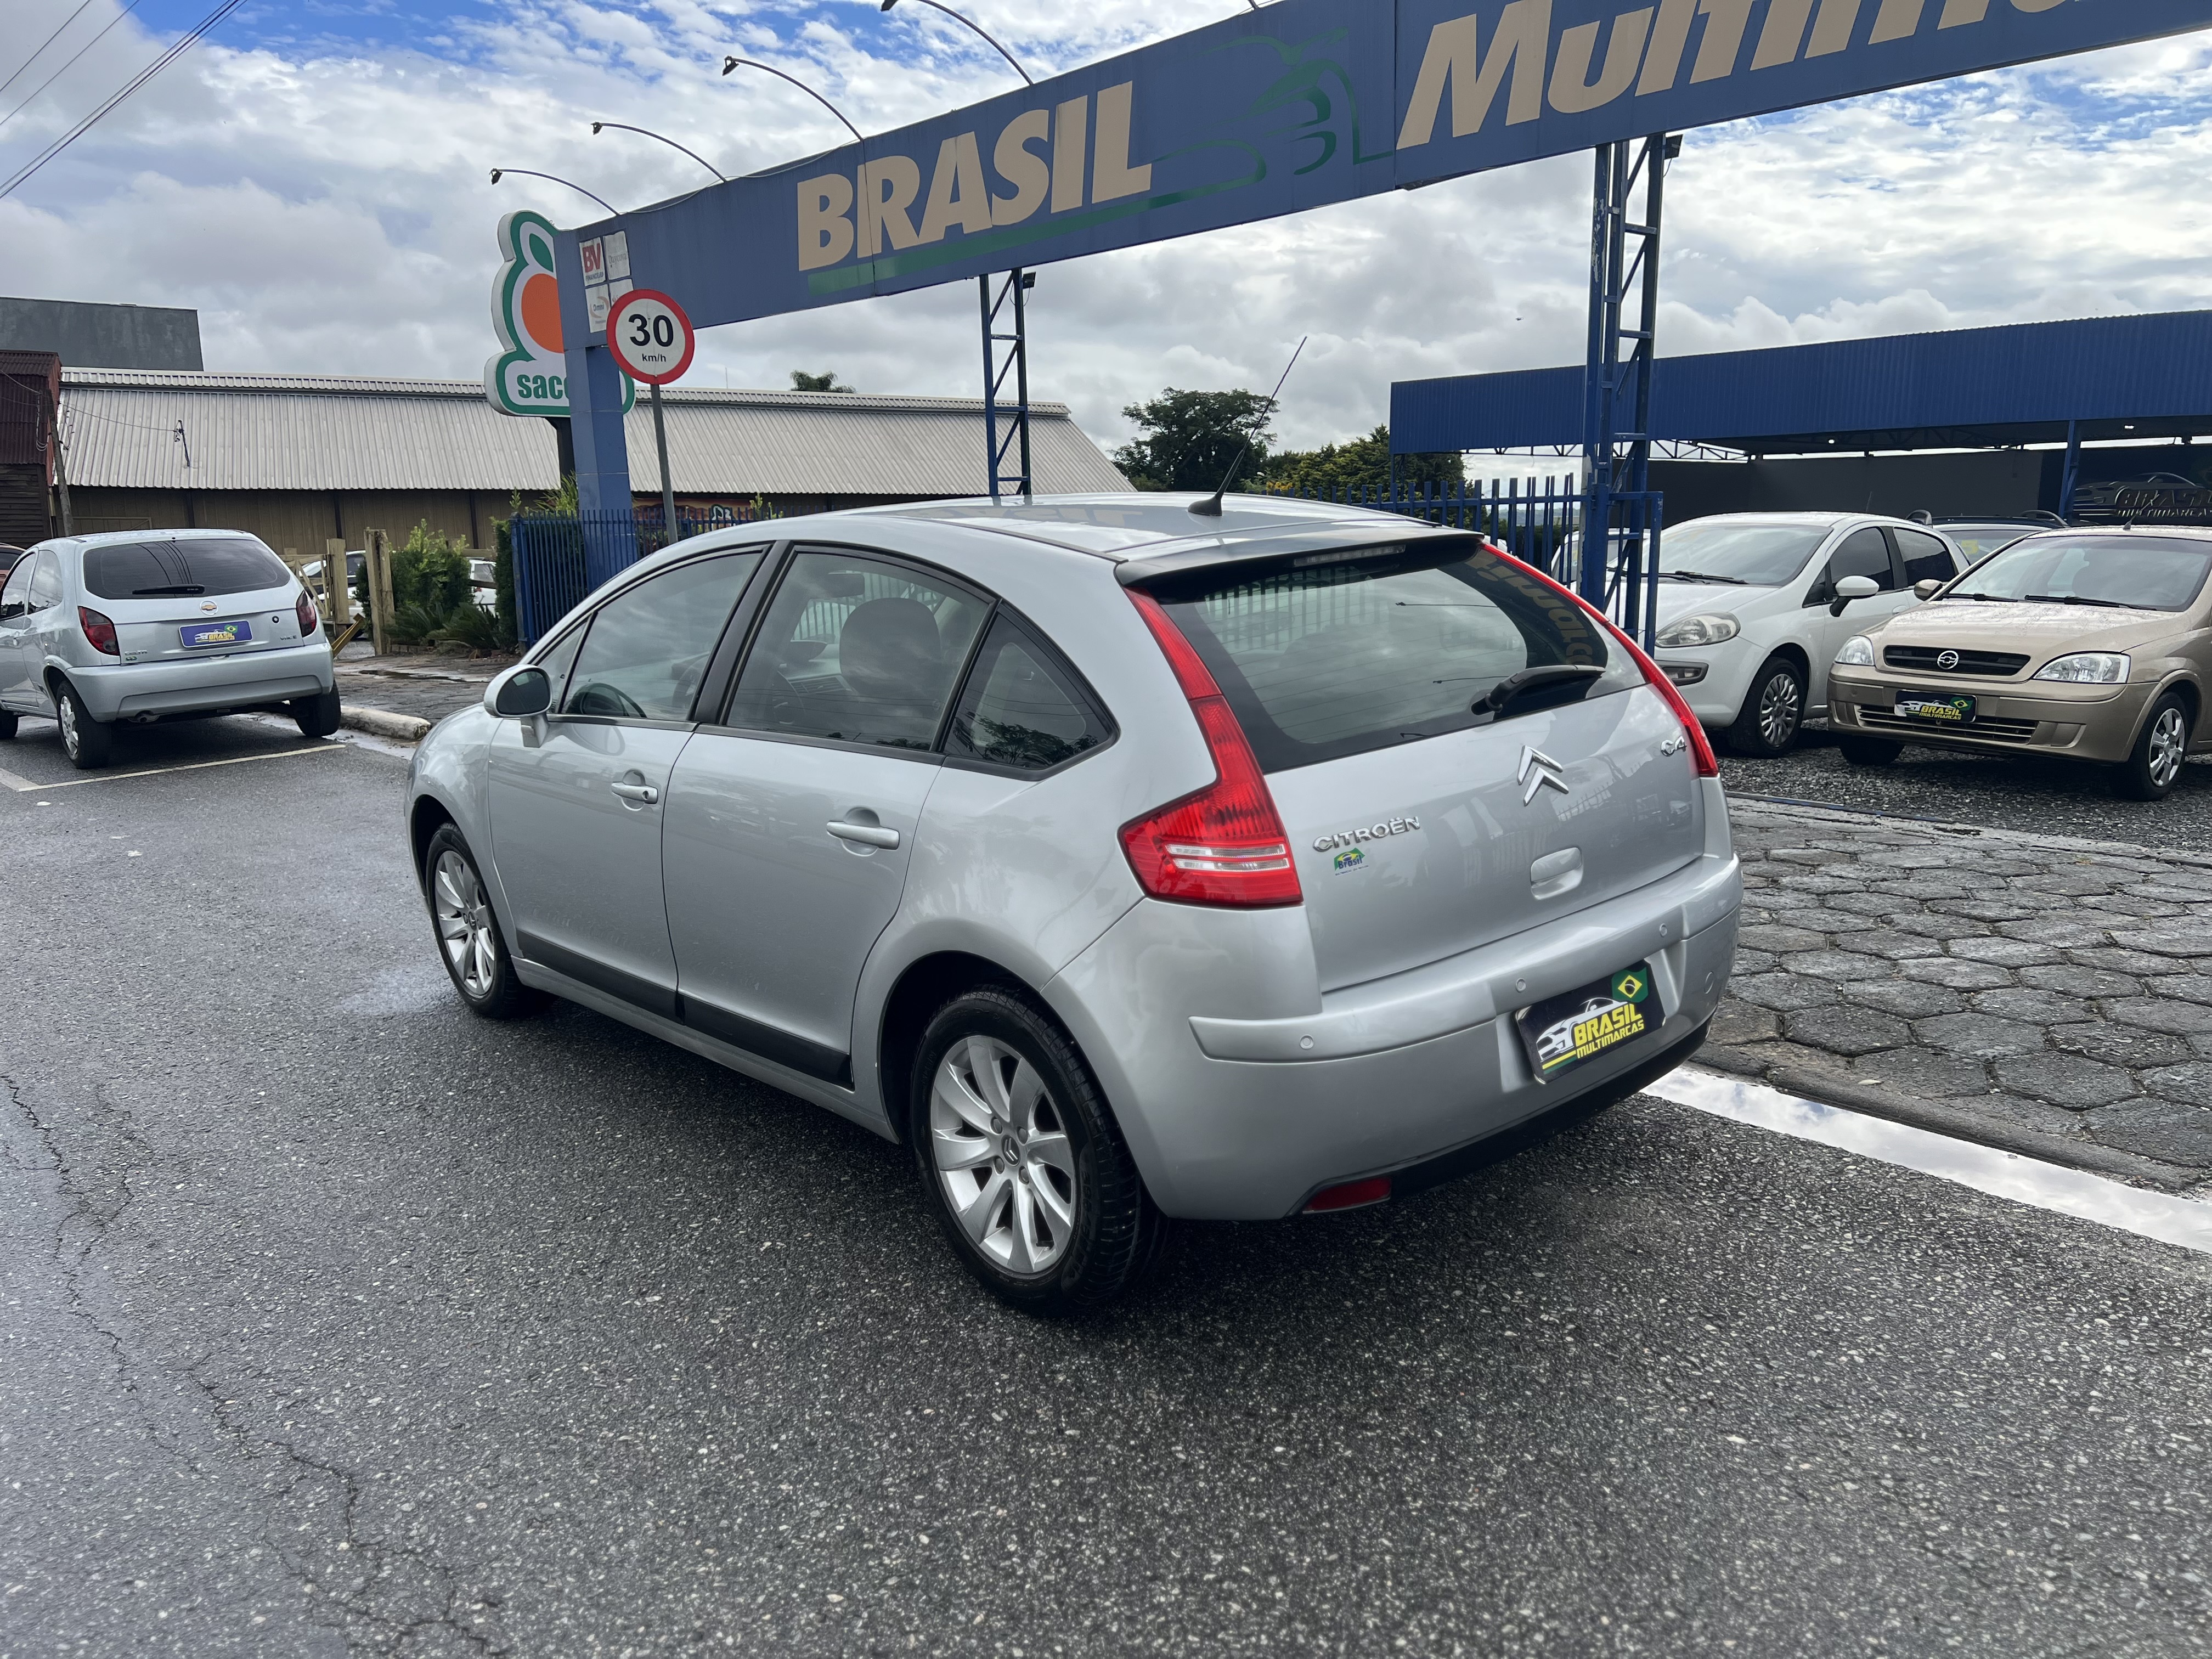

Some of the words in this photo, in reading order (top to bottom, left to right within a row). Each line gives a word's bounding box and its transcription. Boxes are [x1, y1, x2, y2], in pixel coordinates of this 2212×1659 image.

[797, 81, 1152, 271] BRASIL
[583, 243, 601, 273] BV
[629, 314, 673, 347] 30
[642, 353, 666, 362] km/h
[517, 374, 569, 399] sac
[1921, 706, 1962, 716] BRASIL
[1661, 736, 1687, 757] C4
[1312, 816, 1420, 853] CITROËN
[1338, 854, 1363, 870] Brasil
[1574, 1003, 1642, 1047] BRASIL
[1576, 1019, 1644, 1058] MULTIMARCAS
